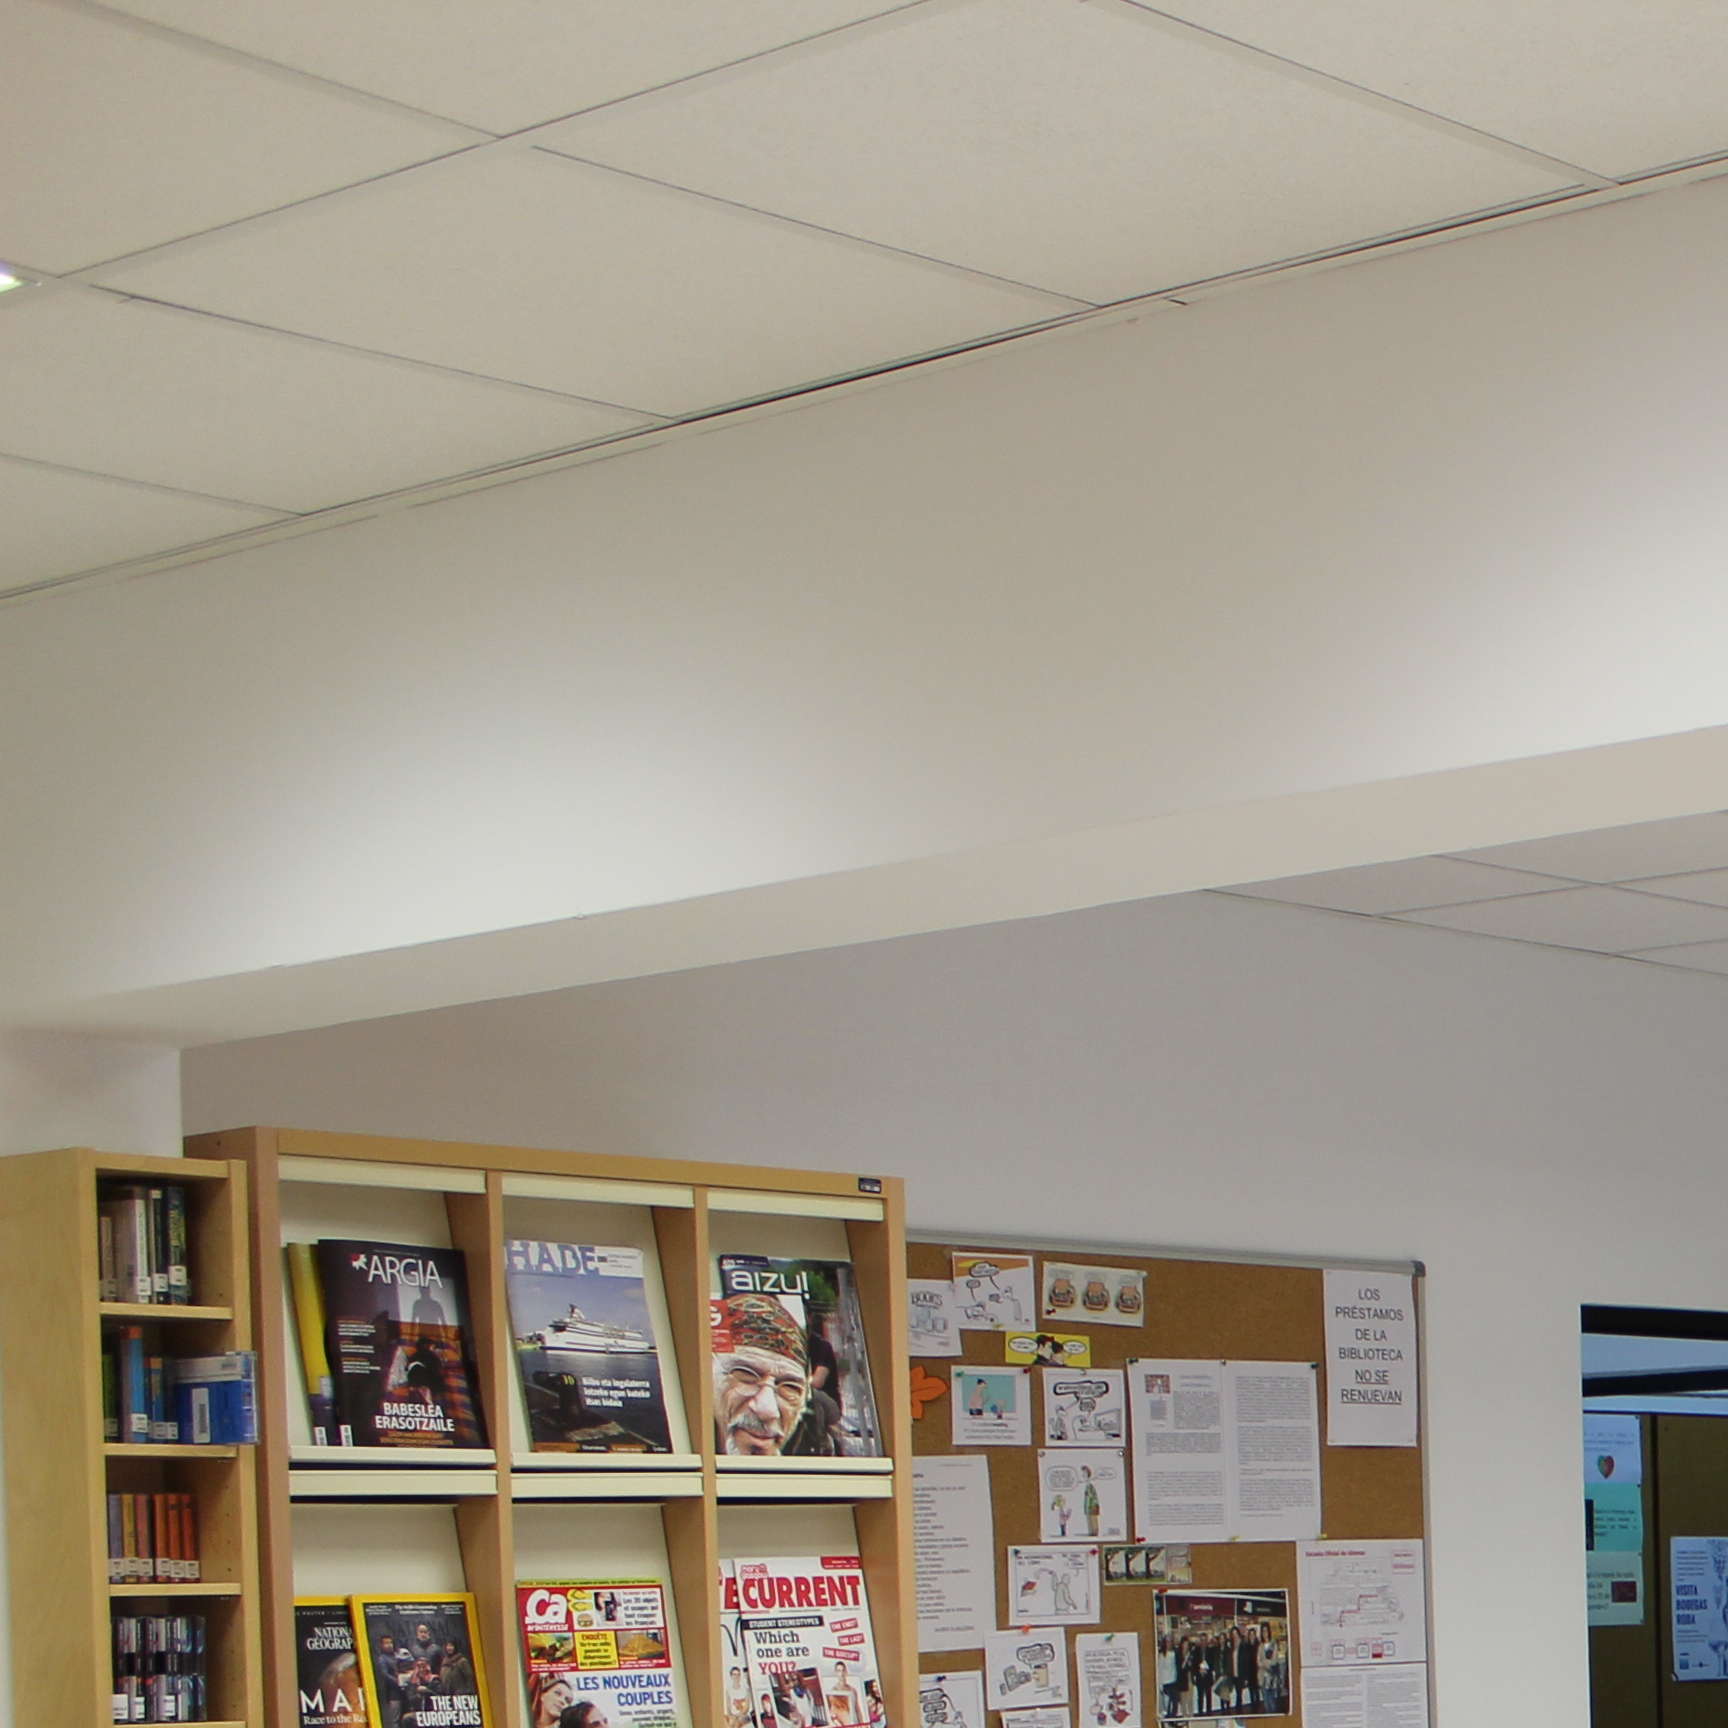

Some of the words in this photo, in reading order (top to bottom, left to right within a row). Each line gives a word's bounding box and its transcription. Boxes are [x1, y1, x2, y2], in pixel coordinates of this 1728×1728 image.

[368, 1255, 443, 1289] ARGIA
[731, 1271, 810, 1300] aizu!
[1358, 1288, 1380, 1301] LOS
[1335, 1305, 1404, 1321] PRÉSTAMOS
[1355, 1329, 1370, 1341] DE
[1373, 1329, 1387, 1341] LA
[1338, 1347, 1403, 1361] BIBLIOTECA
[1355, 1370, 1371, 1383] NO
[1375, 1370, 1389, 1383] SE
[1341, 1389, 1401, 1403] RENUEVAN
[383, 1402, 444, 1418] BABESLEA
[375, 1415, 455, 1432] ERASOTZAILE
[754, 1631, 799, 1644] Which
[756, 1647, 782, 1658] one
[786, 1647, 810, 1657] are
[577, 1676, 600, 1691] LES
[603, 1673, 671, 1690] NOUVEAUX
[430, 1696, 452, 1711] THE
[453, 1695, 479, 1711] NEW
[617, 1691, 673, 1707] COUPLES
[416, 1710, 481, 1727] EUROPEANS
